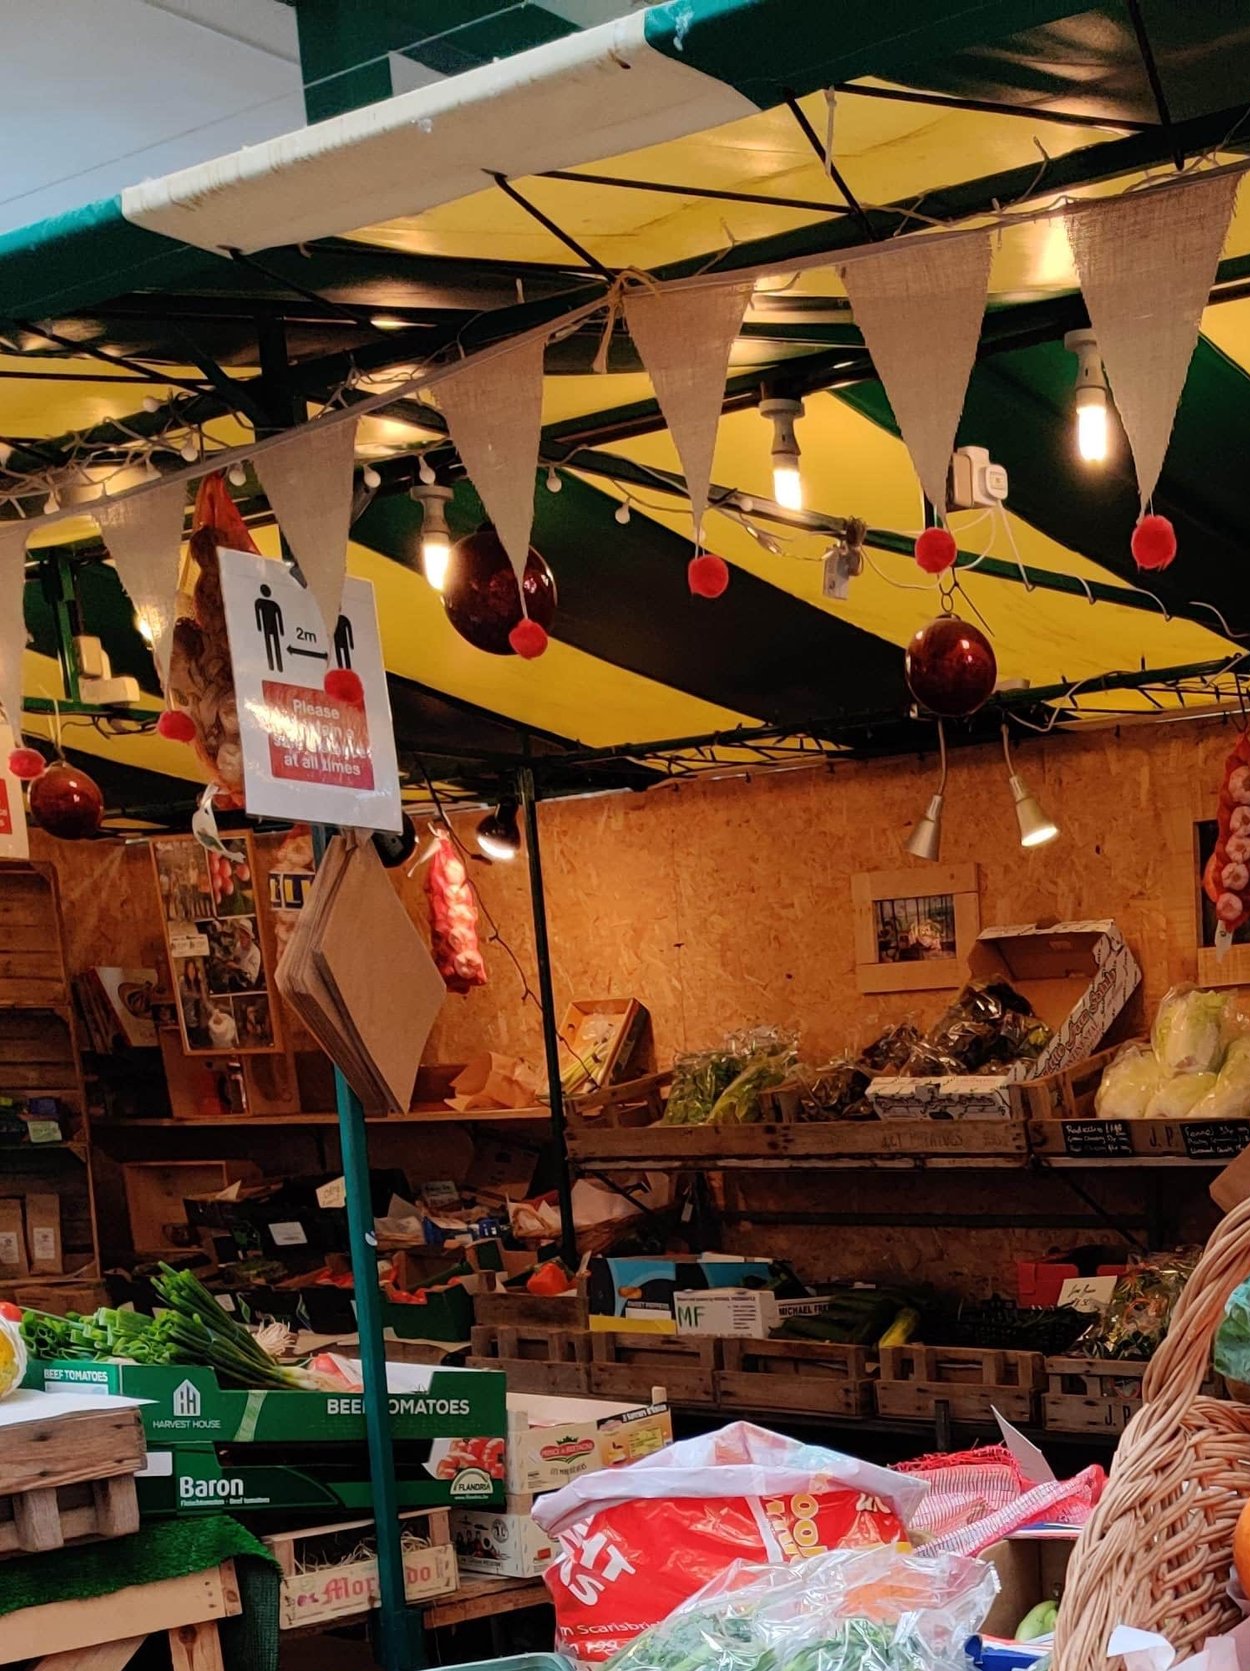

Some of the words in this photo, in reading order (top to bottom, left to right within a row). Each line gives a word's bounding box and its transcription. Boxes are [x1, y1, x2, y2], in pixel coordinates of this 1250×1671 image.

[296, 627, 317, 643] 2m
[293, 699, 340, 720] Please
[284, 754, 299, 767] at
[302, 755, 319, 769] all
[320, 757, 361, 776] times
[677, 1305, 706, 1328] MF
[778, 1304, 813, 1317] MICHAEL
[44, 1368, 64, 1379] BEEF
[65, 1370, 108, 1382] TOMATOES
[388, 1398, 470, 1415] OMATOES
[153, 1419, 190, 1429] HARVEST
[192, 1419, 222, 1429] HOUSE
[179, 1476, 244, 1498] Baron
[458, 1483, 491, 1493] FLANDRIA
